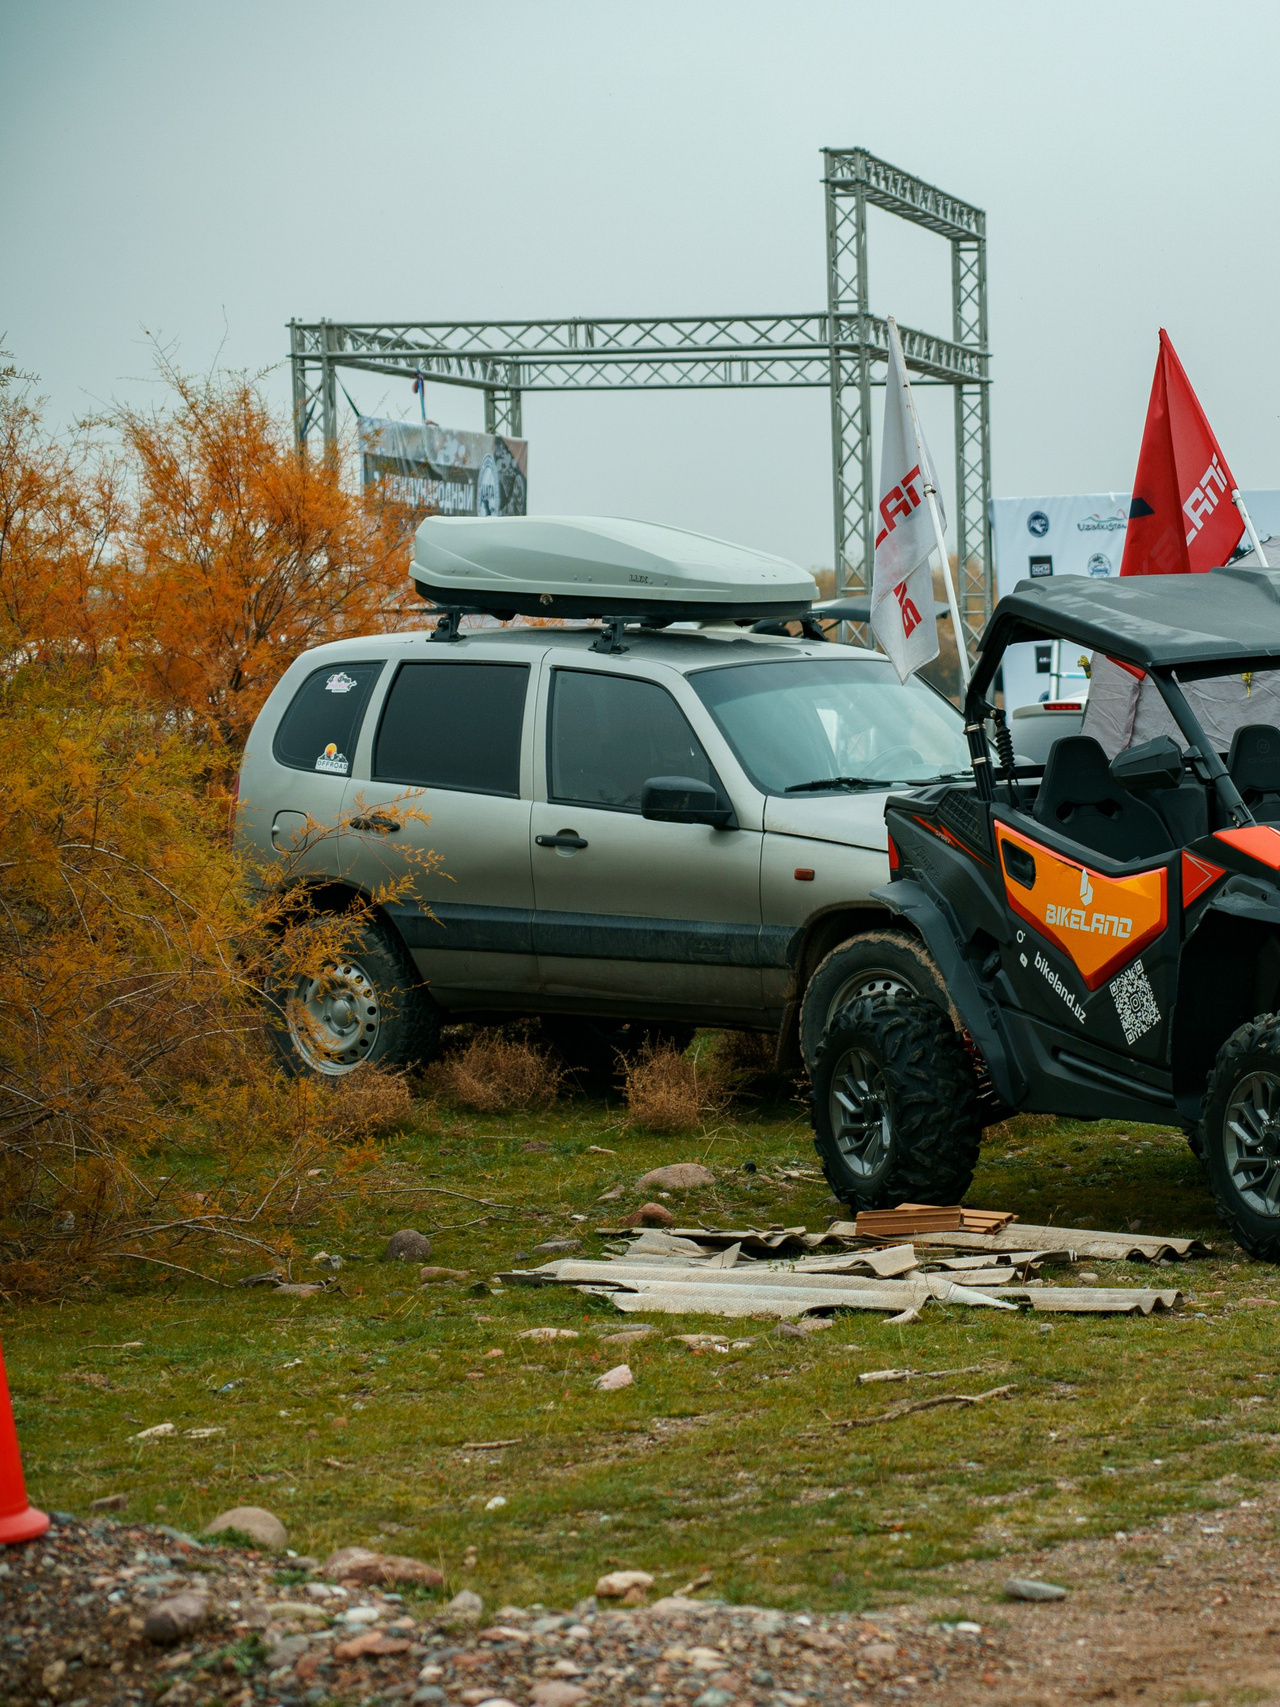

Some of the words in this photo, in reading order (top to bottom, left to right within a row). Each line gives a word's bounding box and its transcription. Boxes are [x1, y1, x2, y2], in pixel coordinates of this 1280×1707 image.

[628, 574, 649, 584] LUX
[317, 760, 348, 770] OFFROAD
[1045, 903, 1133, 938] BIKELAND
[1034, 951, 1088, 1025] bikeland.uz
